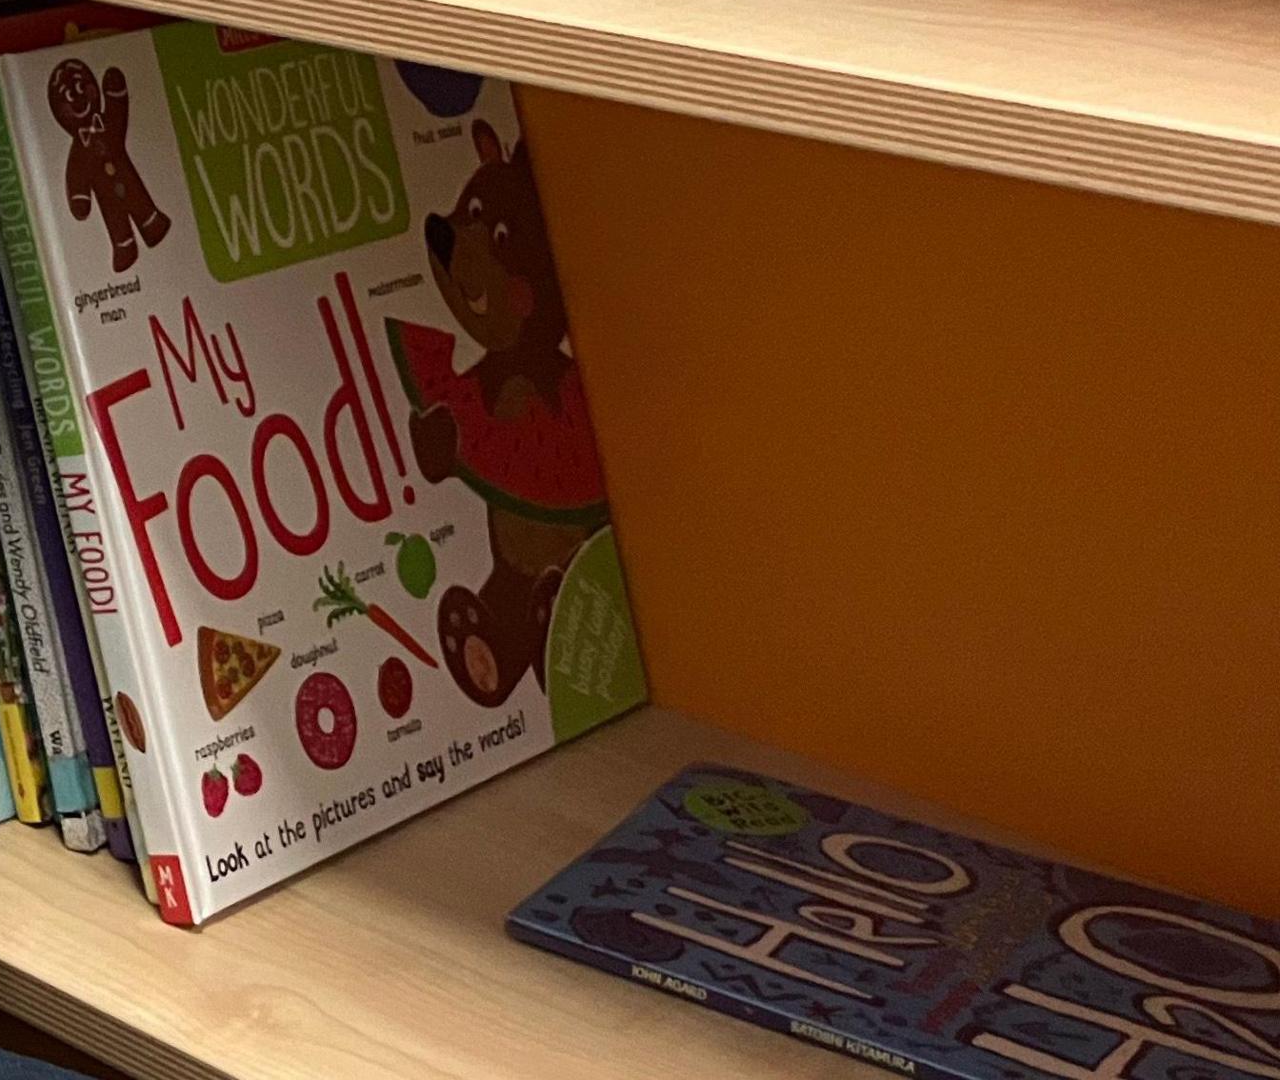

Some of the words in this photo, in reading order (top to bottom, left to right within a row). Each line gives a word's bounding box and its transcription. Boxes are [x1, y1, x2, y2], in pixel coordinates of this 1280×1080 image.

[174, 53, 377, 152] WONDERFUL
[193, 121, 396, 264] WORDS
[74, 274, 142, 312] gingerbread
[99, 305, 127, 325] man
[24, 325, 78, 437] WORDS
[148, 295, 257, 432] My
[85, 271, 417, 648] Food!
[3, 537, 33, 601] Wendy
[19, 602, 50, 676] Oldfield
[194, 725, 256, 759] raspberries
[206, 843, 251, 884] Look
[255, 829, 273, 859] at
[277, 817, 307, 848] the
[311, 783, 376, 848] pictures
[382, 763, 413, 801] and
[416, 753, 446, 784] say
[446, 738, 474, 770] the
[479, 709, 527, 754] words!
